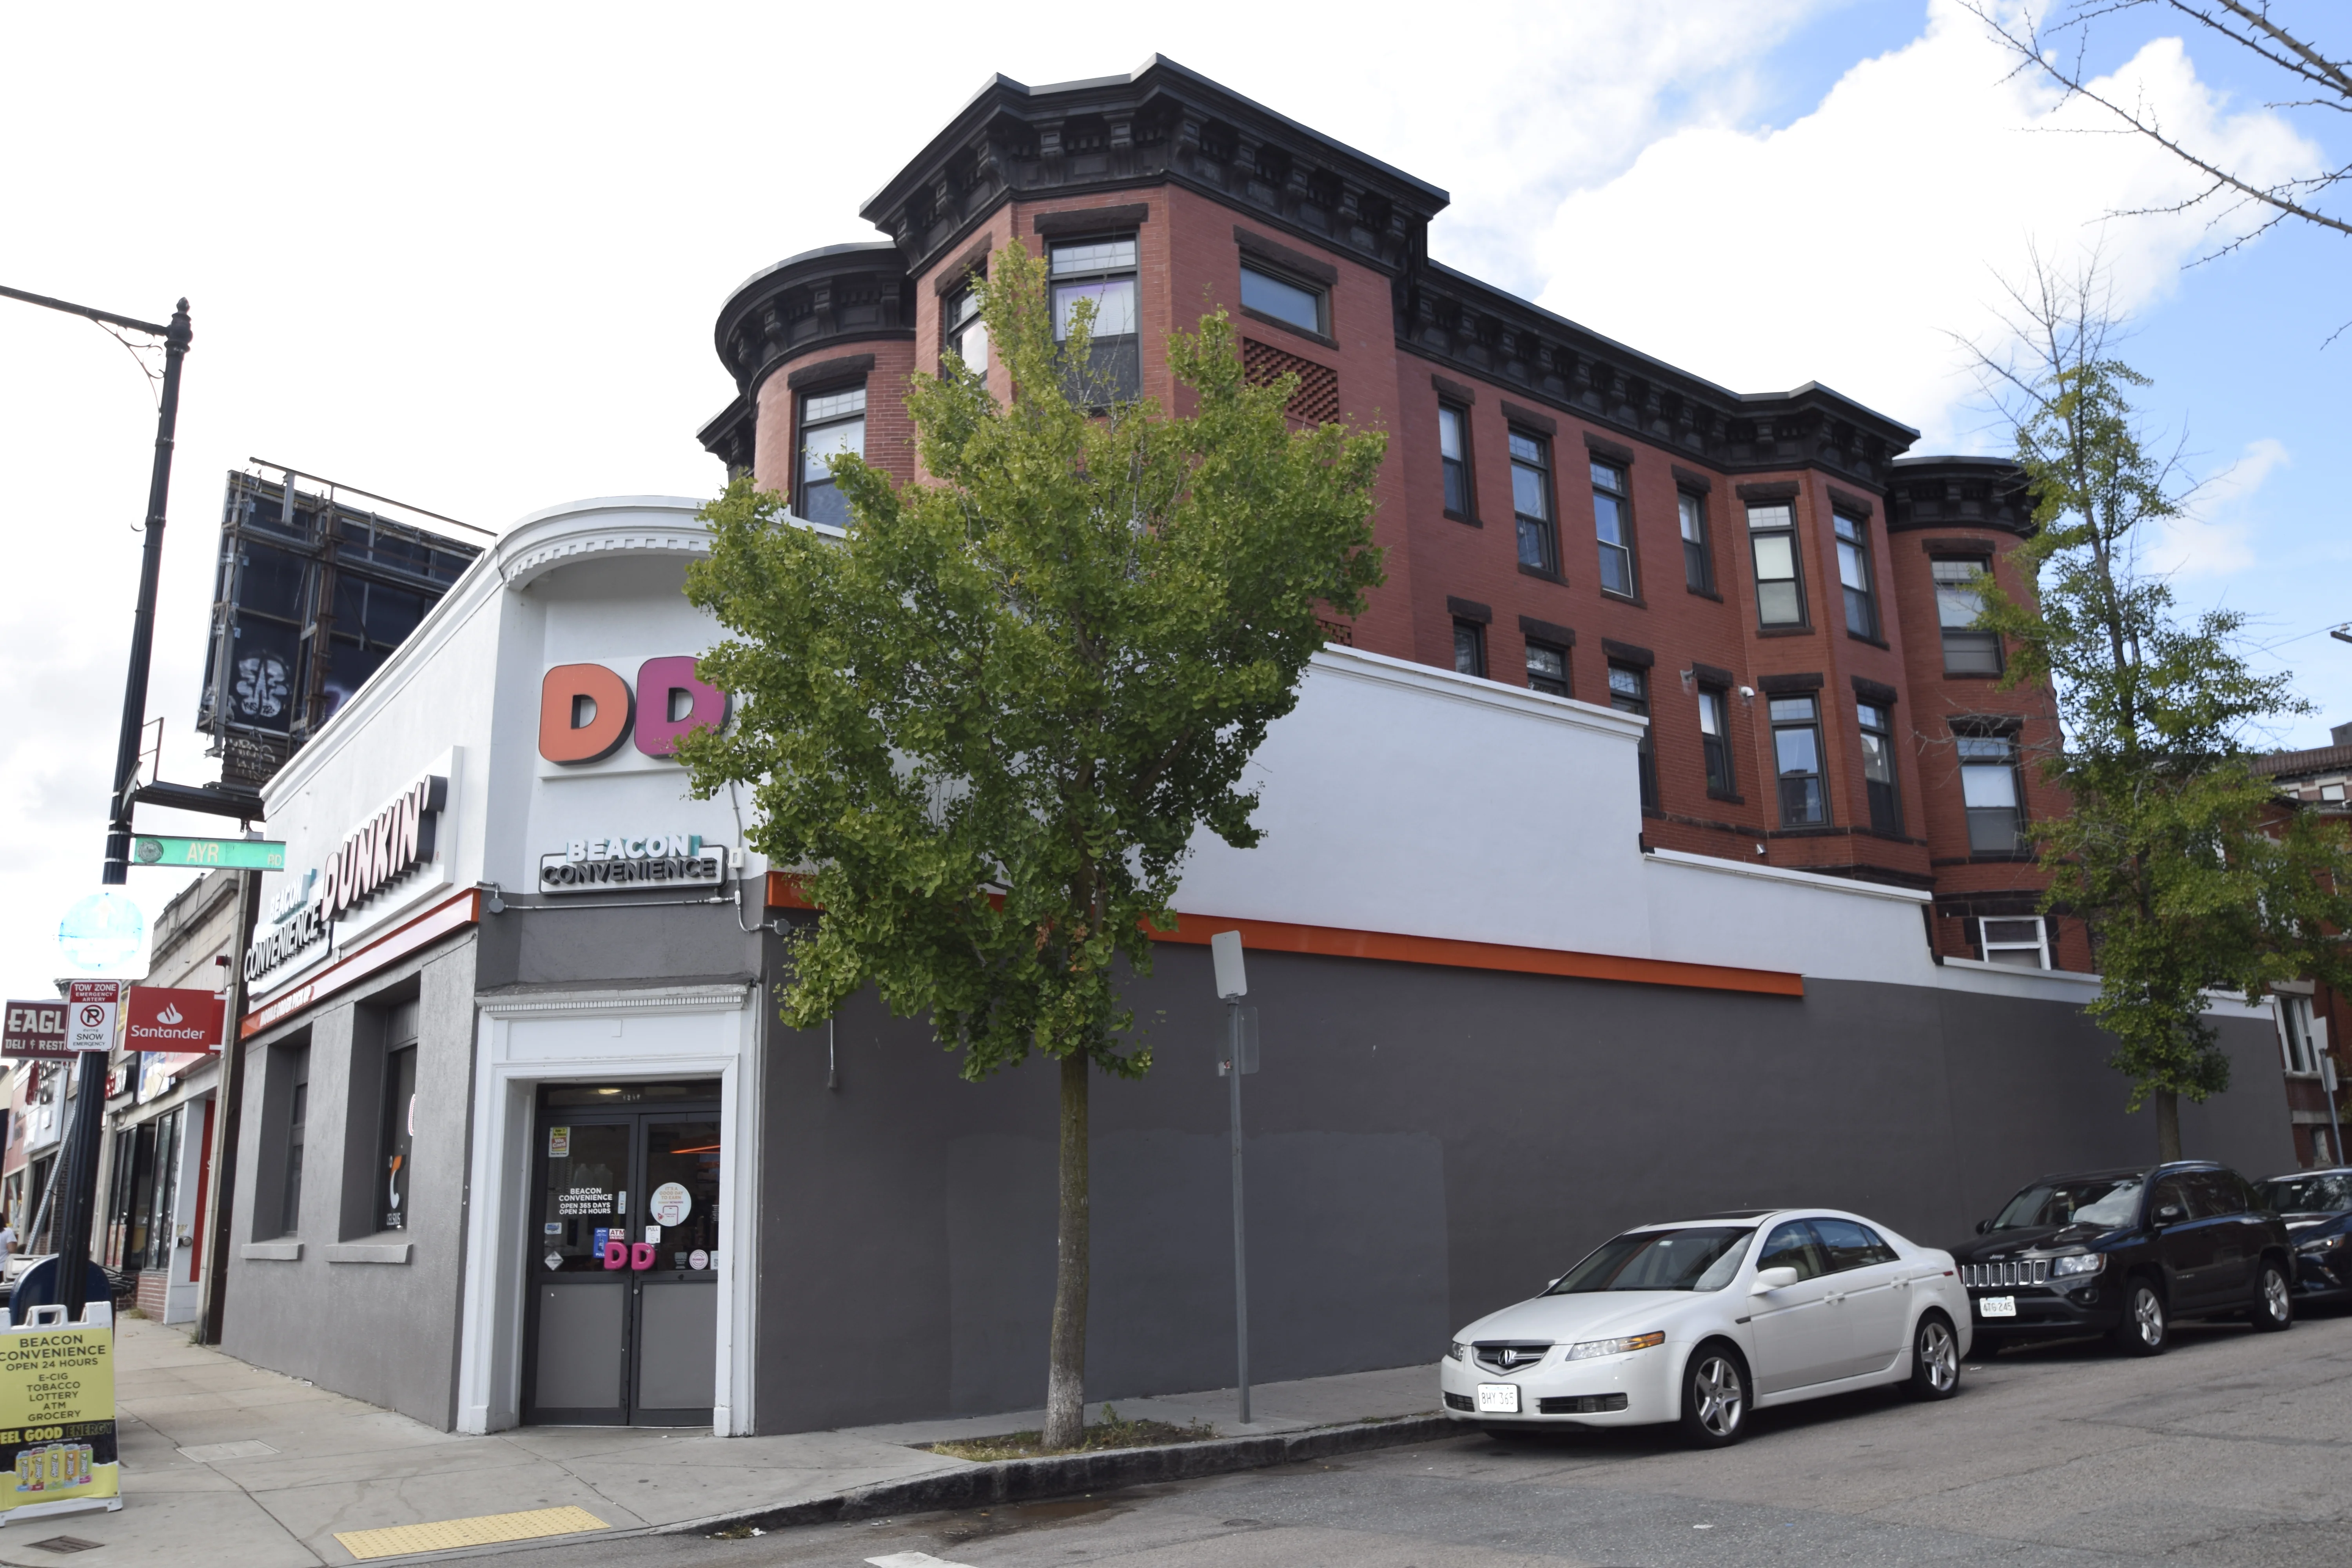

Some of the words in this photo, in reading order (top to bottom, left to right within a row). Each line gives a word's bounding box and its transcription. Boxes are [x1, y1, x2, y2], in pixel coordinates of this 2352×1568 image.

[187, 843, 219, 863] AYR
[267, 854, 282, 866] RD
[321, 774, 431, 922] DUNKIN'
[567, 834, 692, 862] BEACON
[541, 857, 717, 885] CONVENIENCE
[270, 874, 305, 921] BEACON
[244, 899, 321, 982] CONVENIENCE
[303, 984, 311, 1004] UP
[8, 1009, 65, 1034] EAGL
[131, 1025, 205, 1040] Santander
[5, 1039, 25, 1050] DELI
[1998, 1302, 2013, 1312] 245
[20, 1334, 83, 1348] BEACON
[6, 1362, 38, 1371] OPEN
[60, 1357, 98, 1367] HOURS
[39, 1373, 68, 1381] E-CIG
[27, 1381, 81, 1392] TOBACCO
[29, 1391, 79, 1402] LOTTERY
[1482, 1392, 1496, 1404] 8HY
[1499, 1392, 1514, 1405] 365
[43, 1402, 66, 1410] ATM
[28, 1410, 81, 1422] GROCERY
[0, 1431, 21, 1444] EEL
[25, 1426, 63, 1442] GOOD
[66, 1422, 113, 1437] ENERGY
